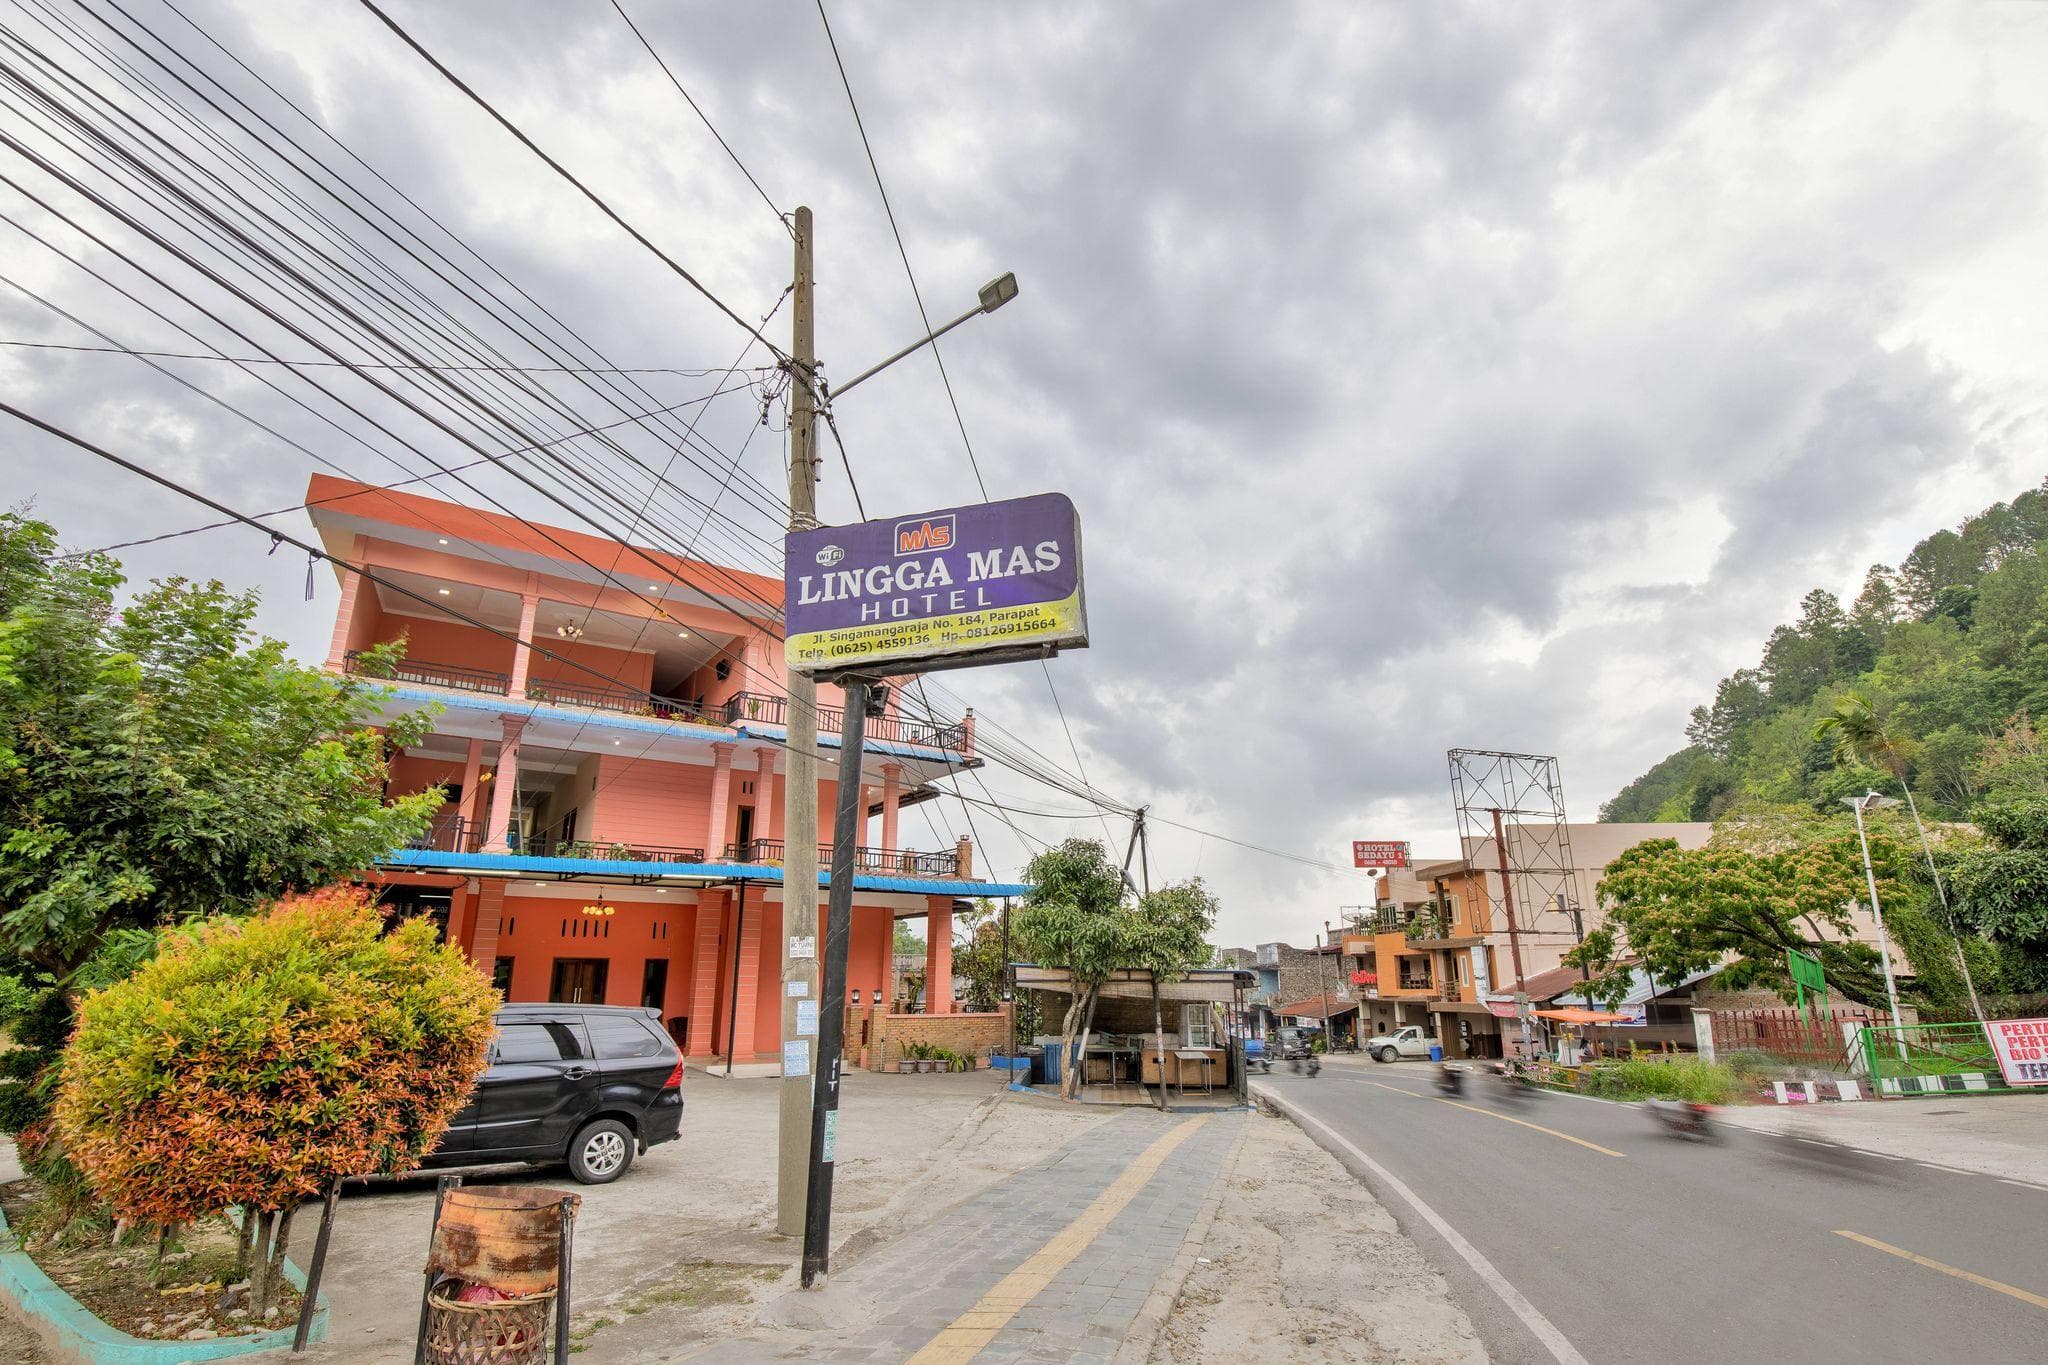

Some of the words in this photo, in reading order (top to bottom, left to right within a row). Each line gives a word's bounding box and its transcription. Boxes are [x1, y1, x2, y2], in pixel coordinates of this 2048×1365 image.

[900, 521, 950, 552] MAS
[797, 557, 954, 606] LINGGA
[966, 540, 1061, 582] MAS
[861, 587, 992, 621] HOTEL
[813, 635, 826, 644] Jl.
[829, 621, 929, 642] Singamangaraja
[933, 620, 953, 629] No.
[958, 614, 985, 626] 184,
[989, 607, 1041, 622] Parapat
[831, 641, 873, 657] (0625)
[876, 634, 930, 650] 4559136
[966, 618, 1057, 639] 08126915664
[1357, 851, 1394, 859] SEDAYU
[2009, 1048, 2042, 1060] BIO
